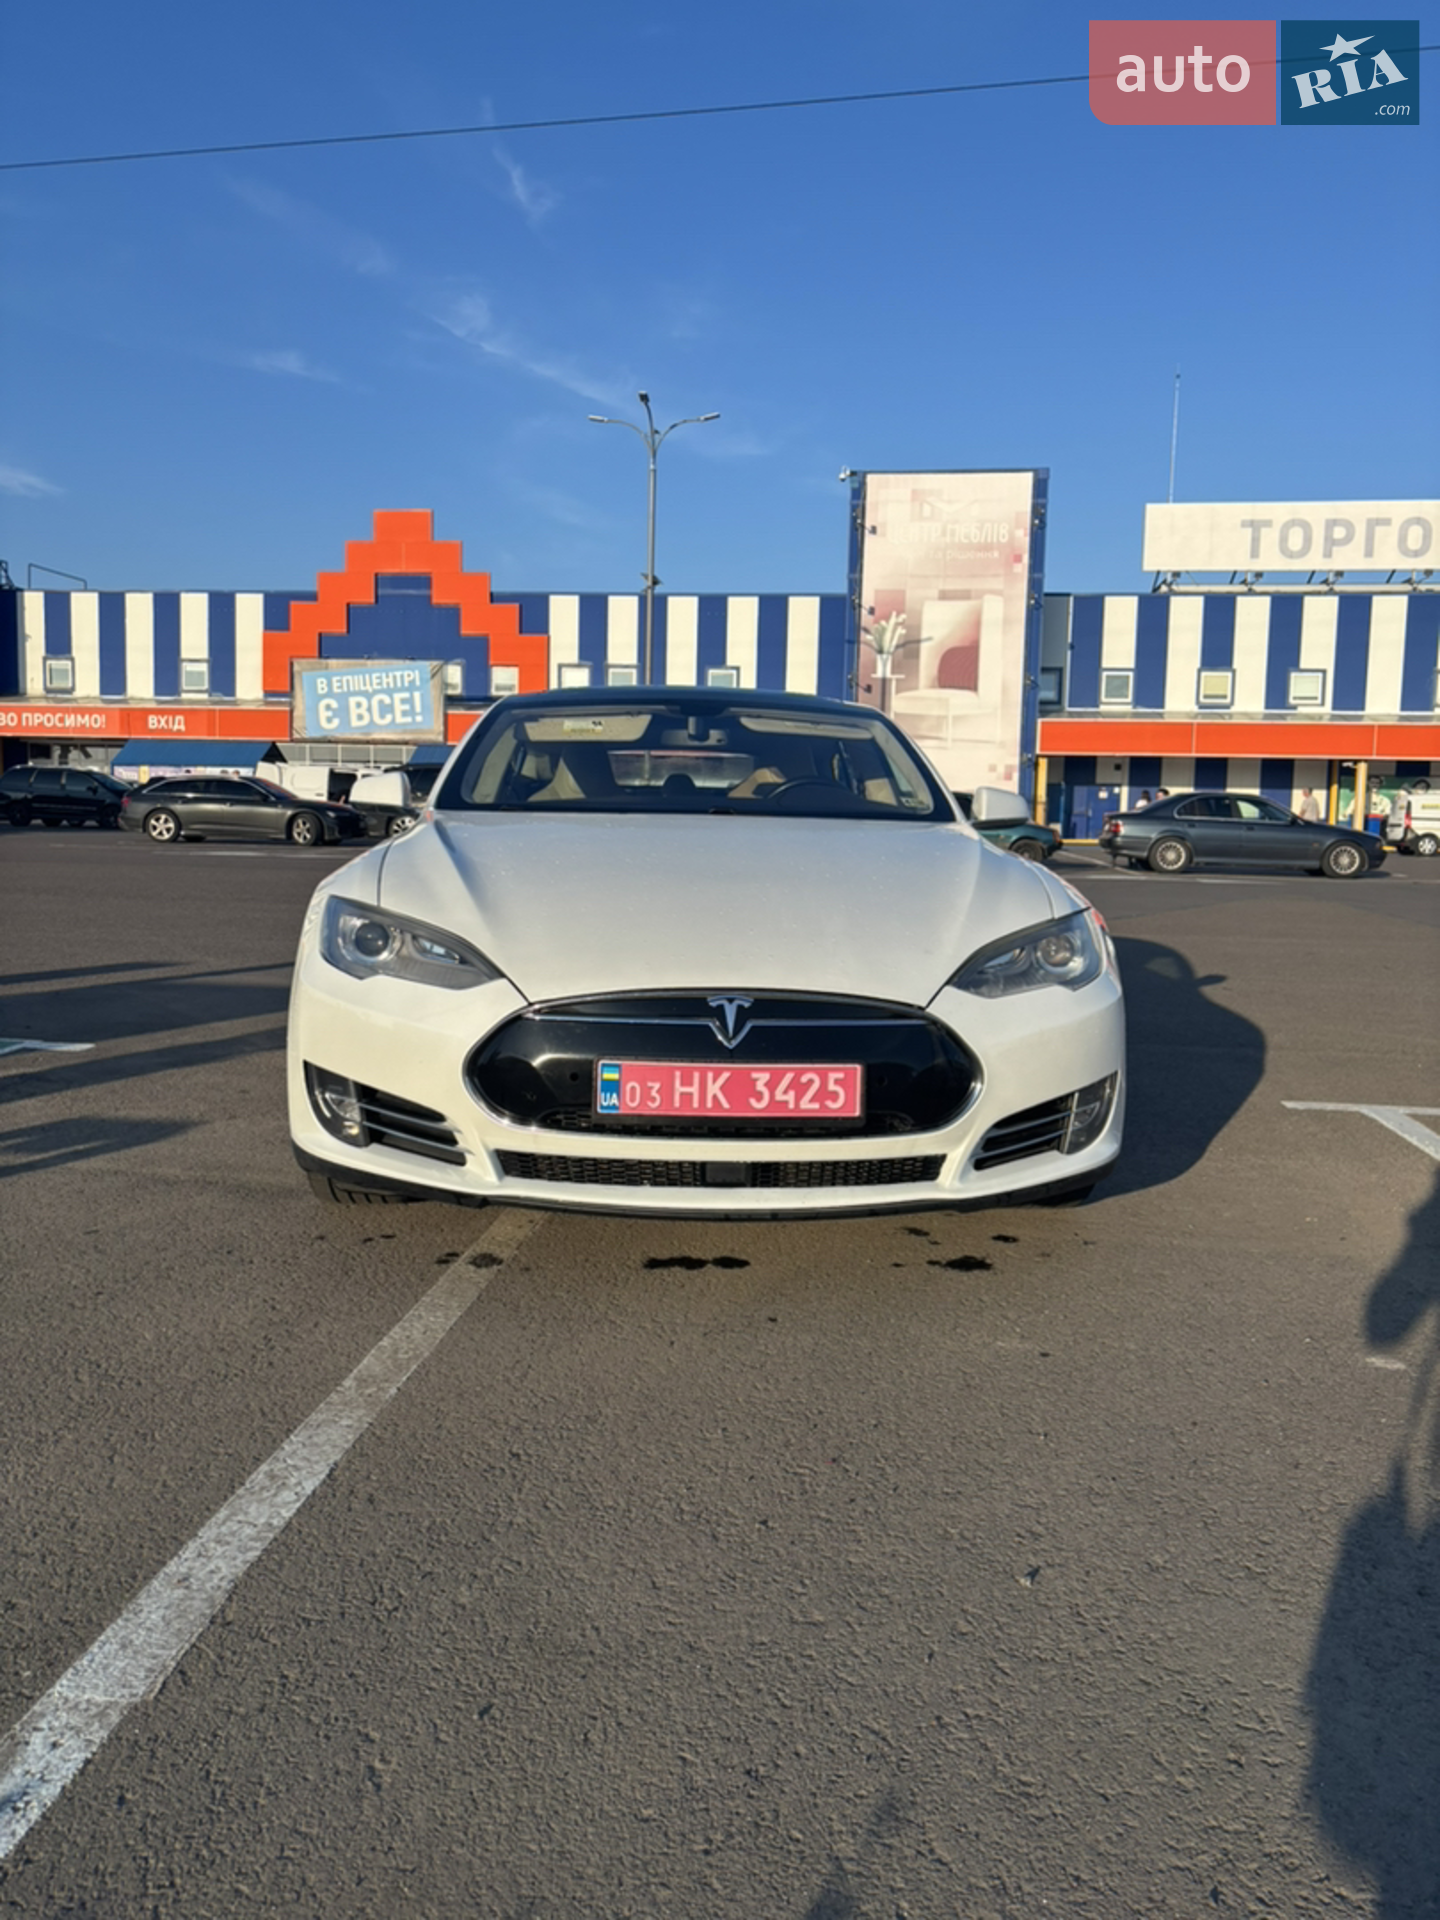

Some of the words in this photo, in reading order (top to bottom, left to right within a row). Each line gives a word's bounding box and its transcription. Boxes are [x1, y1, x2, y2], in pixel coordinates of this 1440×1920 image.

[1240, 516, 1433, 560] ТОРГО
[316, 677, 328, 695] В
[332, 670, 421, 693] ЕПІЦЕНТРІ
[21, 712, 107, 729] ПРОСИМО!
[147, 714, 186, 732] ВХІД
[317, 698, 341, 730] Є
[348, 691, 424, 728] ВСЕ!
[600, 1091, 619, 1107] UA
[748, 1071, 847, 1110] 3425
